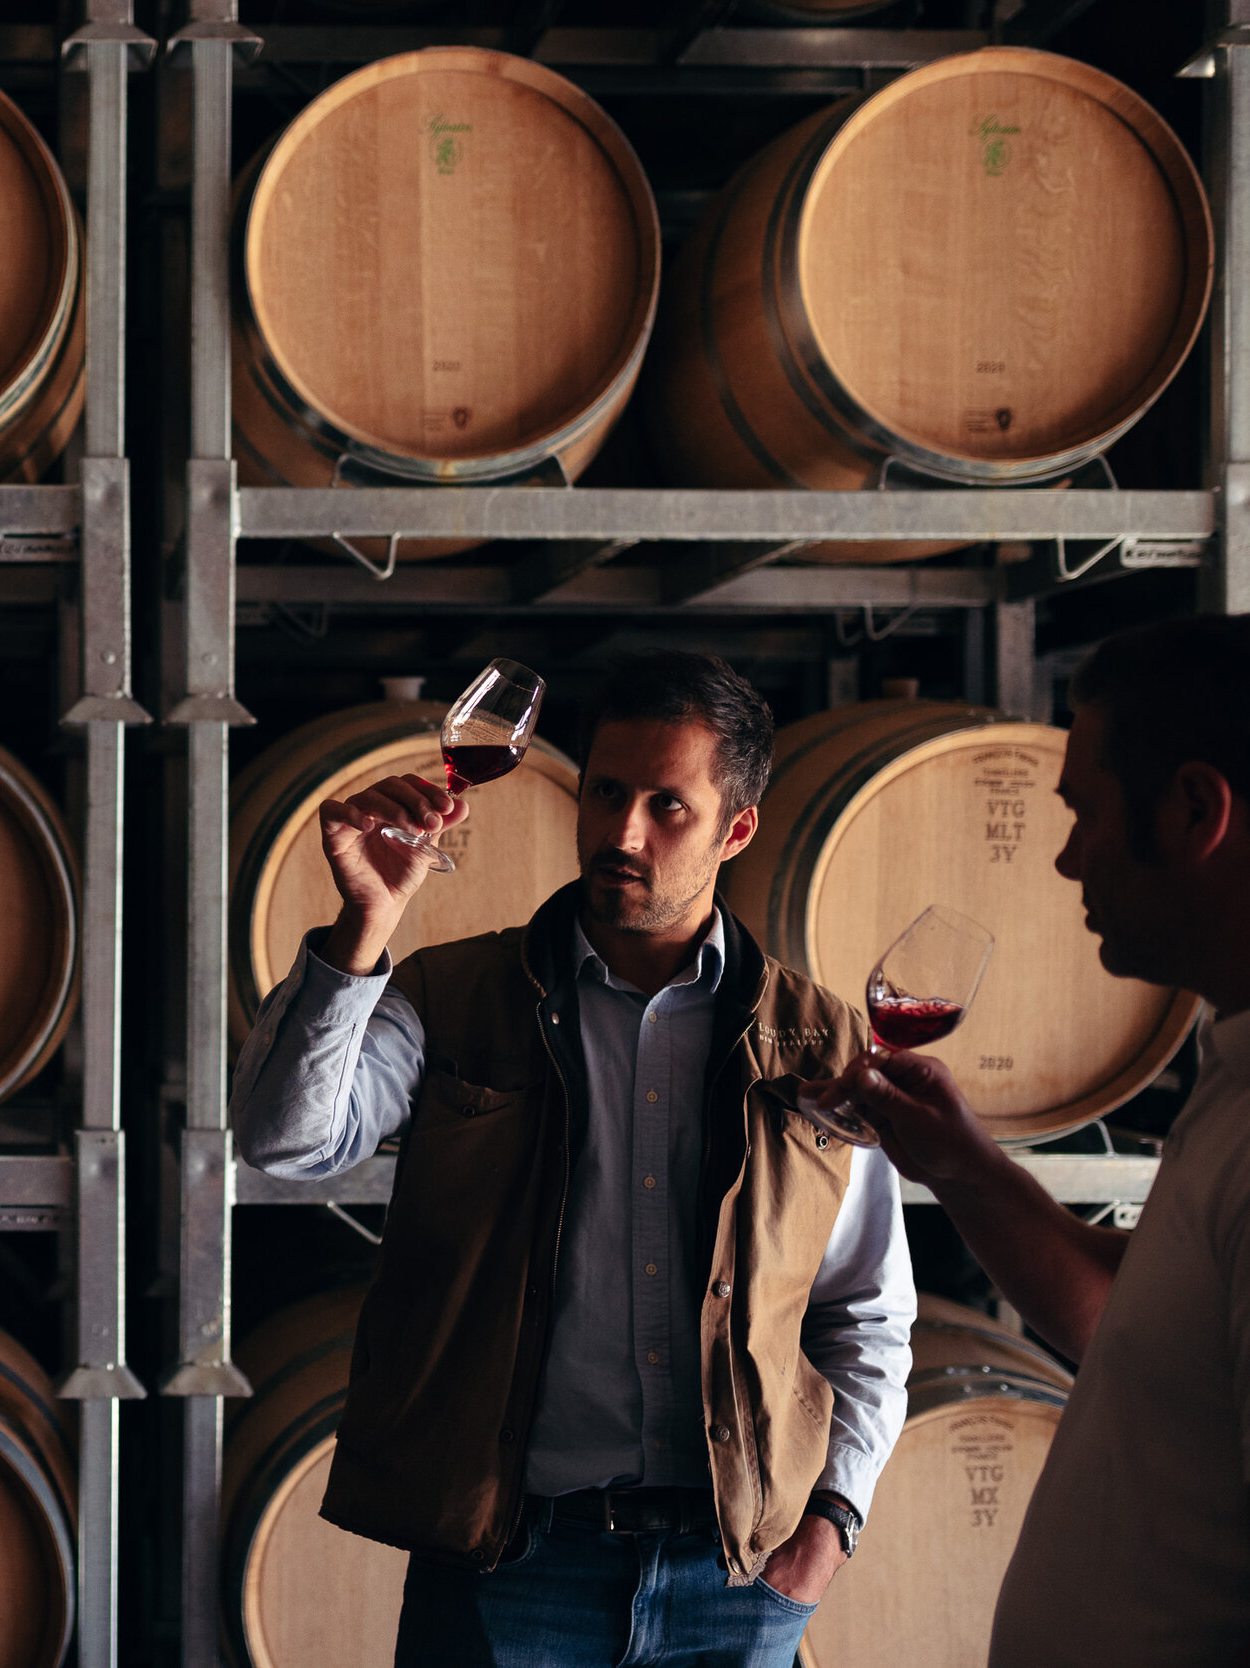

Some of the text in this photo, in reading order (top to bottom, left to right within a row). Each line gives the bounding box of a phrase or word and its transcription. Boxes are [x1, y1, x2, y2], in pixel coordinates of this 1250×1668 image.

[986, 800, 1025, 818] VTG
[439, 829, 470, 848] LT
[985, 823, 1025, 842] MLT
[990, 845, 1017, 864] 3Y
[804, 1027, 829, 1037] BAY
[979, 1055, 1014, 1071] 2020
[965, 1466, 1004, 1482] VTG
[970, 1487, 998, 1505] MX
[972, 1509, 998, 1527] 3Y
